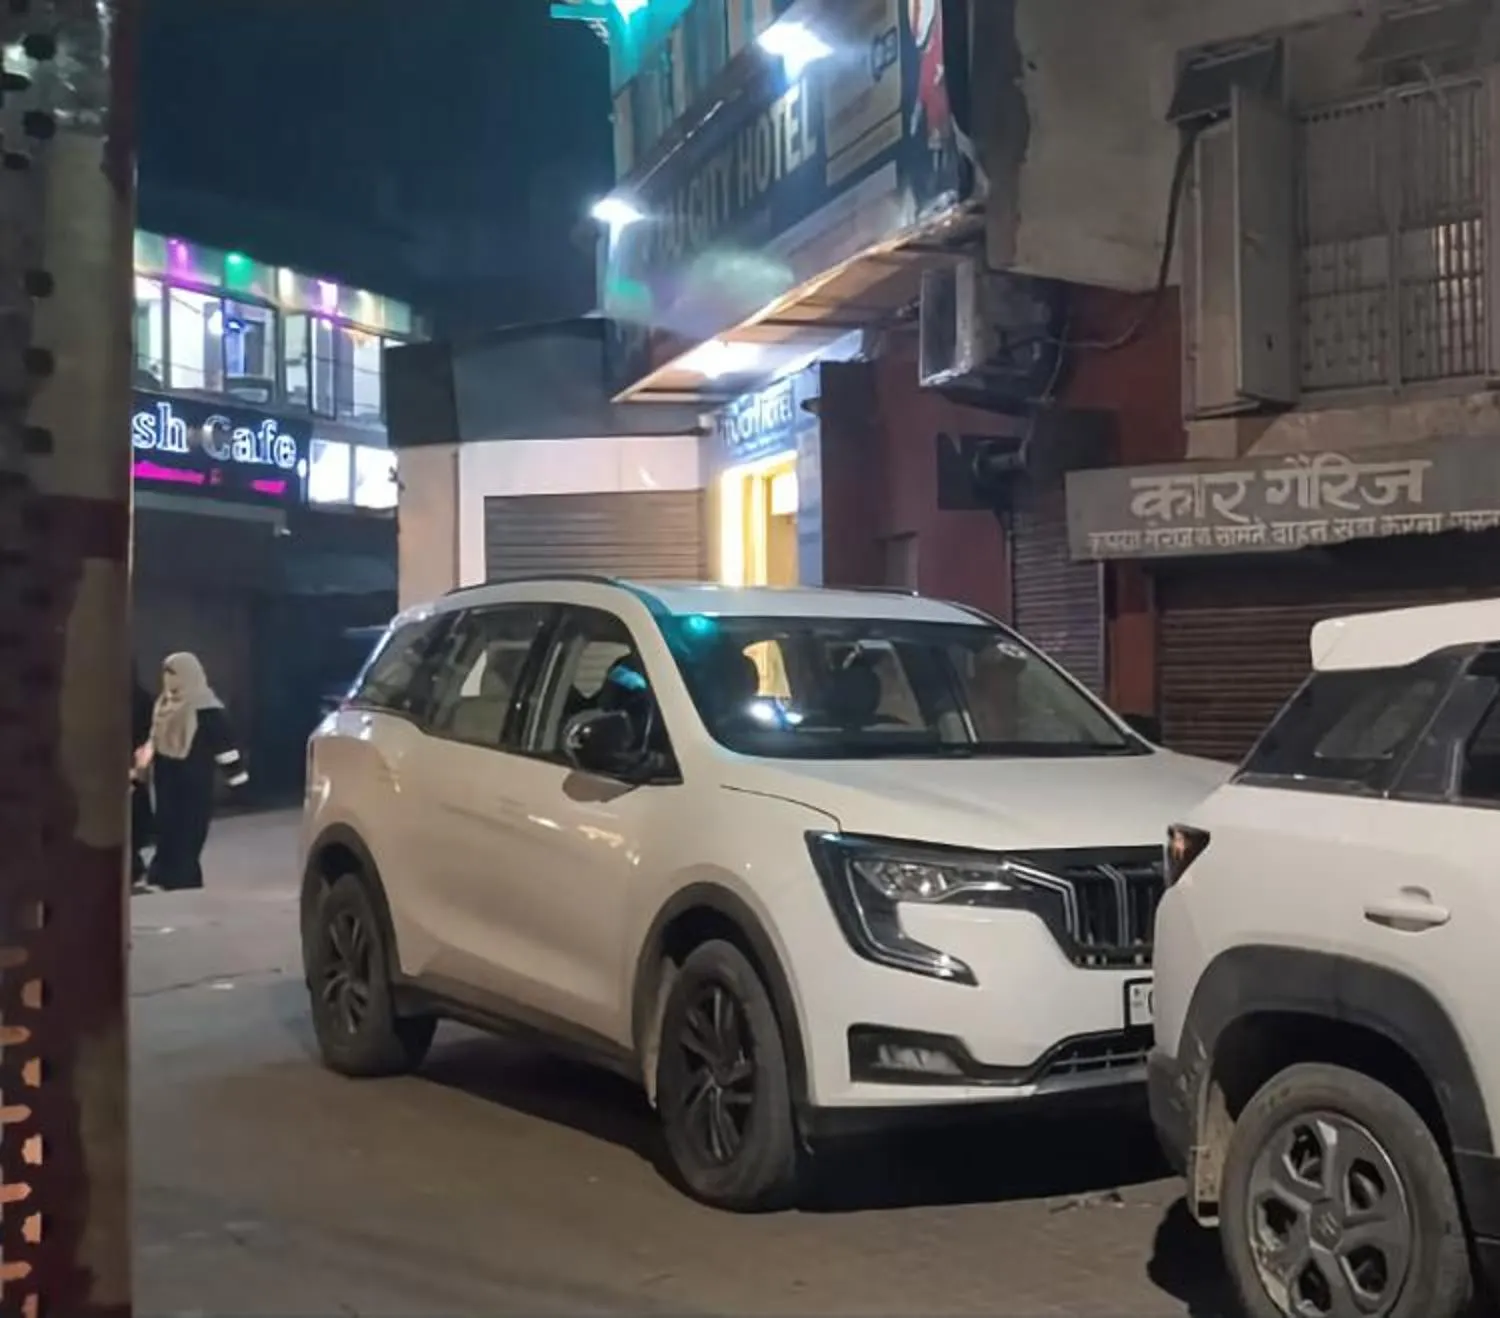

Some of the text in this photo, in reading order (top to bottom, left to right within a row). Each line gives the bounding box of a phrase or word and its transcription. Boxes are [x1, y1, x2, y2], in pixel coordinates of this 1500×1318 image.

[738, 77, 817, 208] HOTEL
[202, 415, 297, 468] Cafe
[1130, 467, 1255, 523] कार
